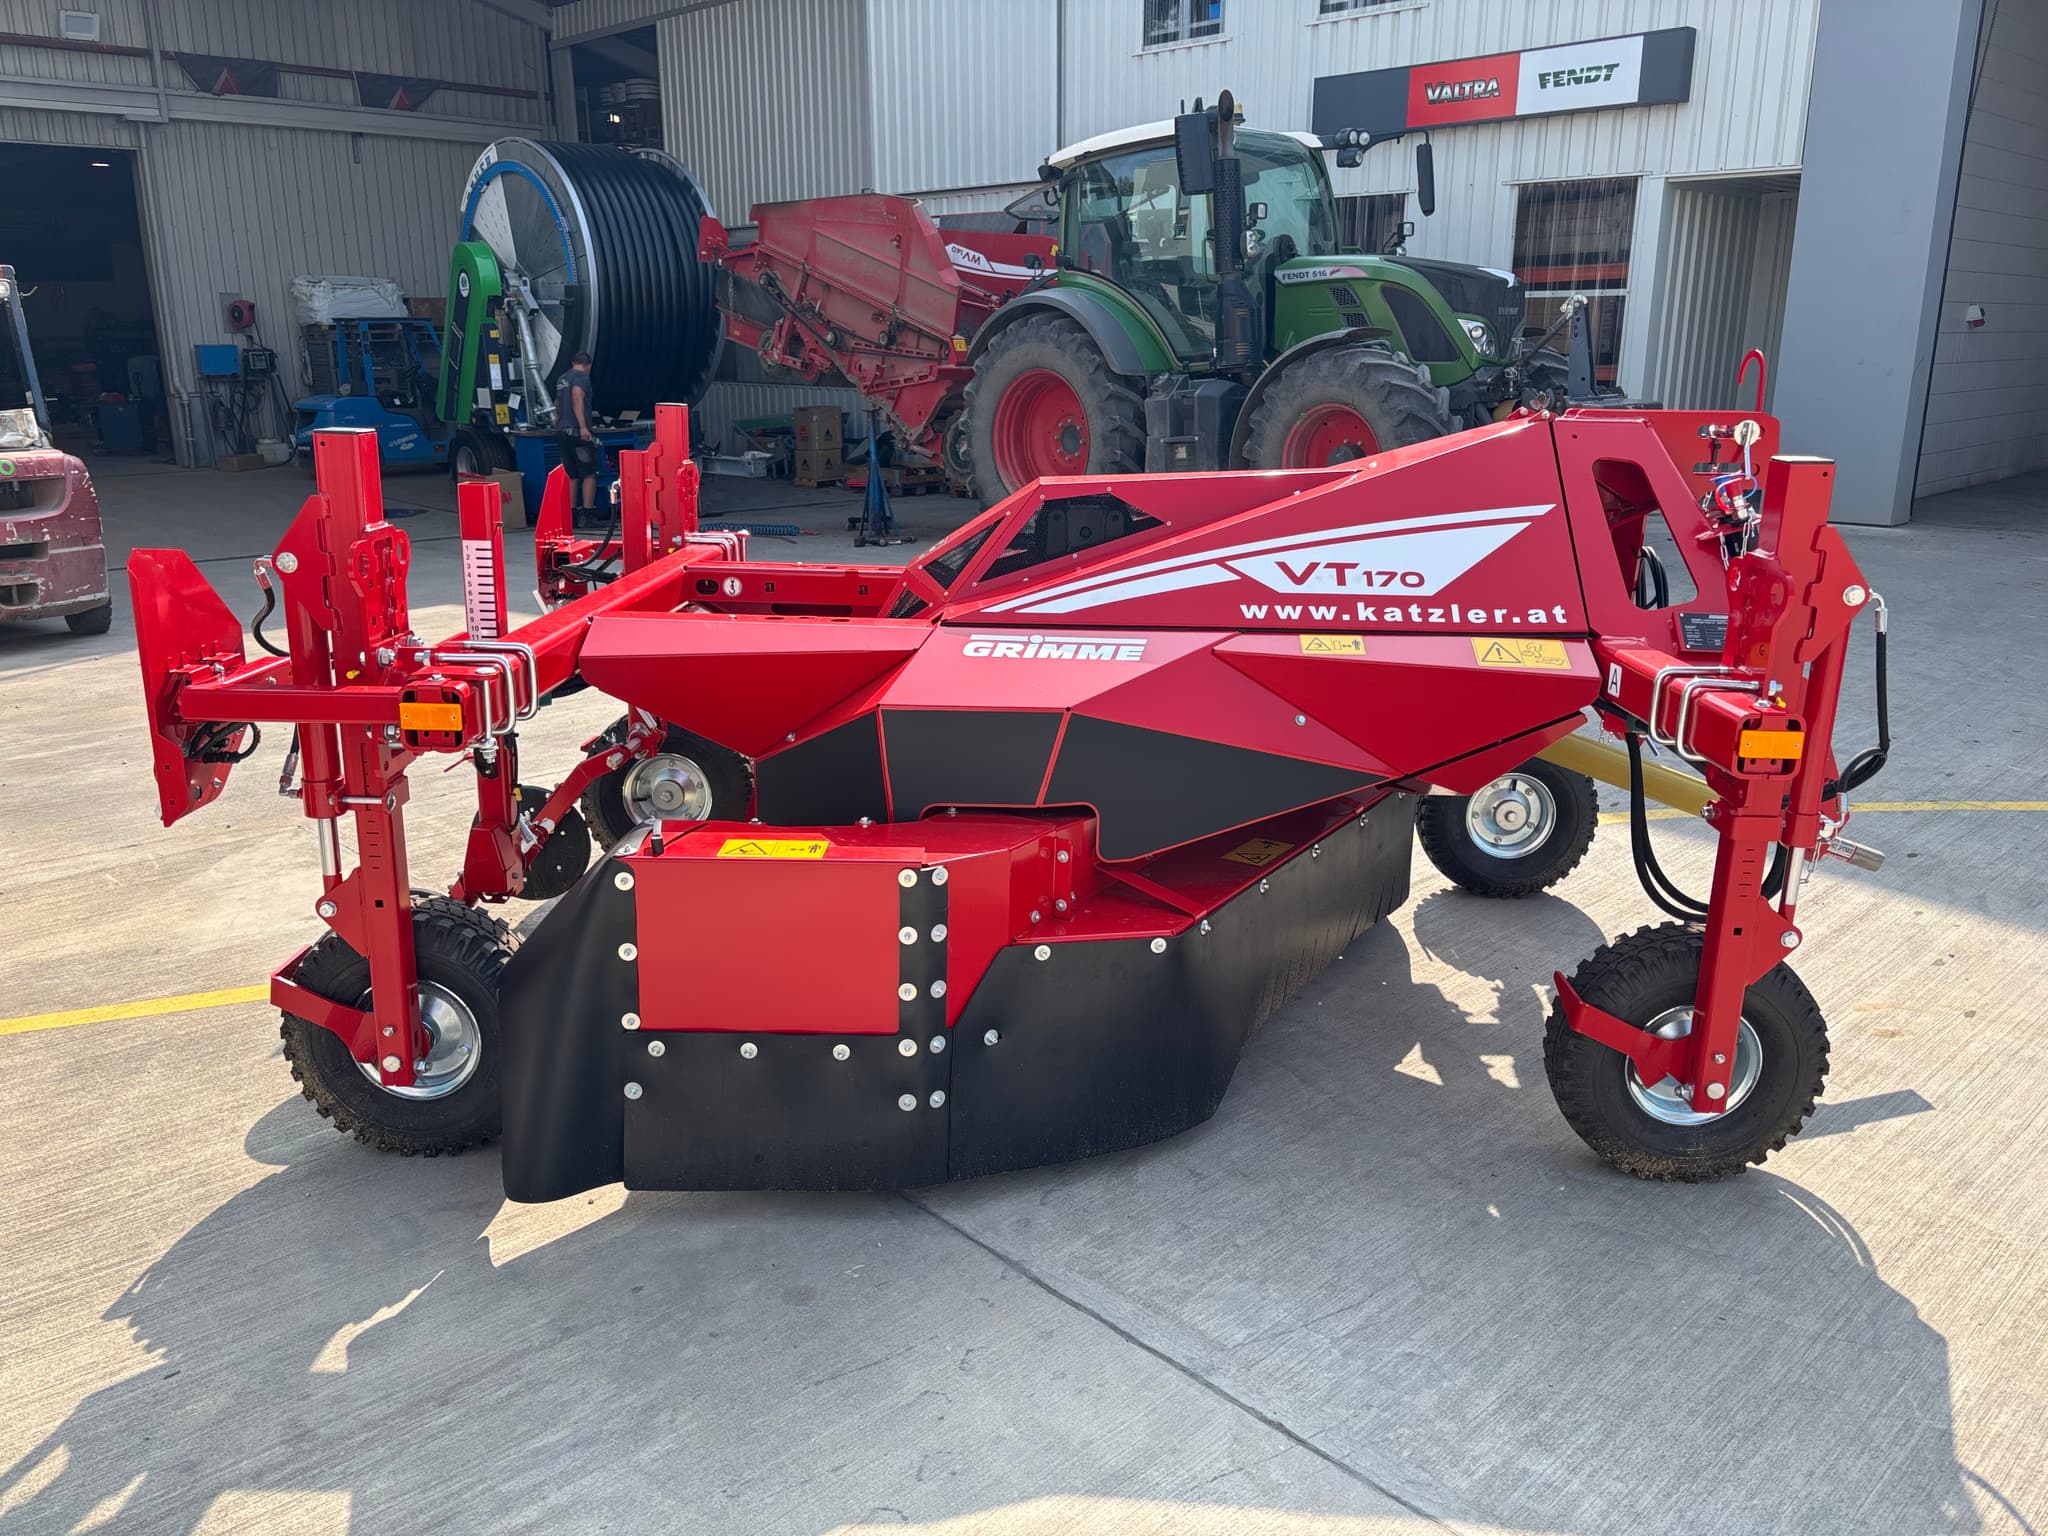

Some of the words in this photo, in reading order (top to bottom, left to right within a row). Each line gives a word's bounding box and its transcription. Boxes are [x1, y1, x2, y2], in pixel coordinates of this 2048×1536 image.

[1538, 63, 1620, 89] FENDT
[1425, 78, 1500, 104] VALTRA
[1282, 271, 1309, 280] FENDT
[1274, 561, 1360, 587] VT
[1362, 570, 1426, 588] 170
[1239, 601, 1568, 624] www.katzler.at
[963, 634, 1147, 662] GRIMME
[1609, 667, 1619, 694] A
